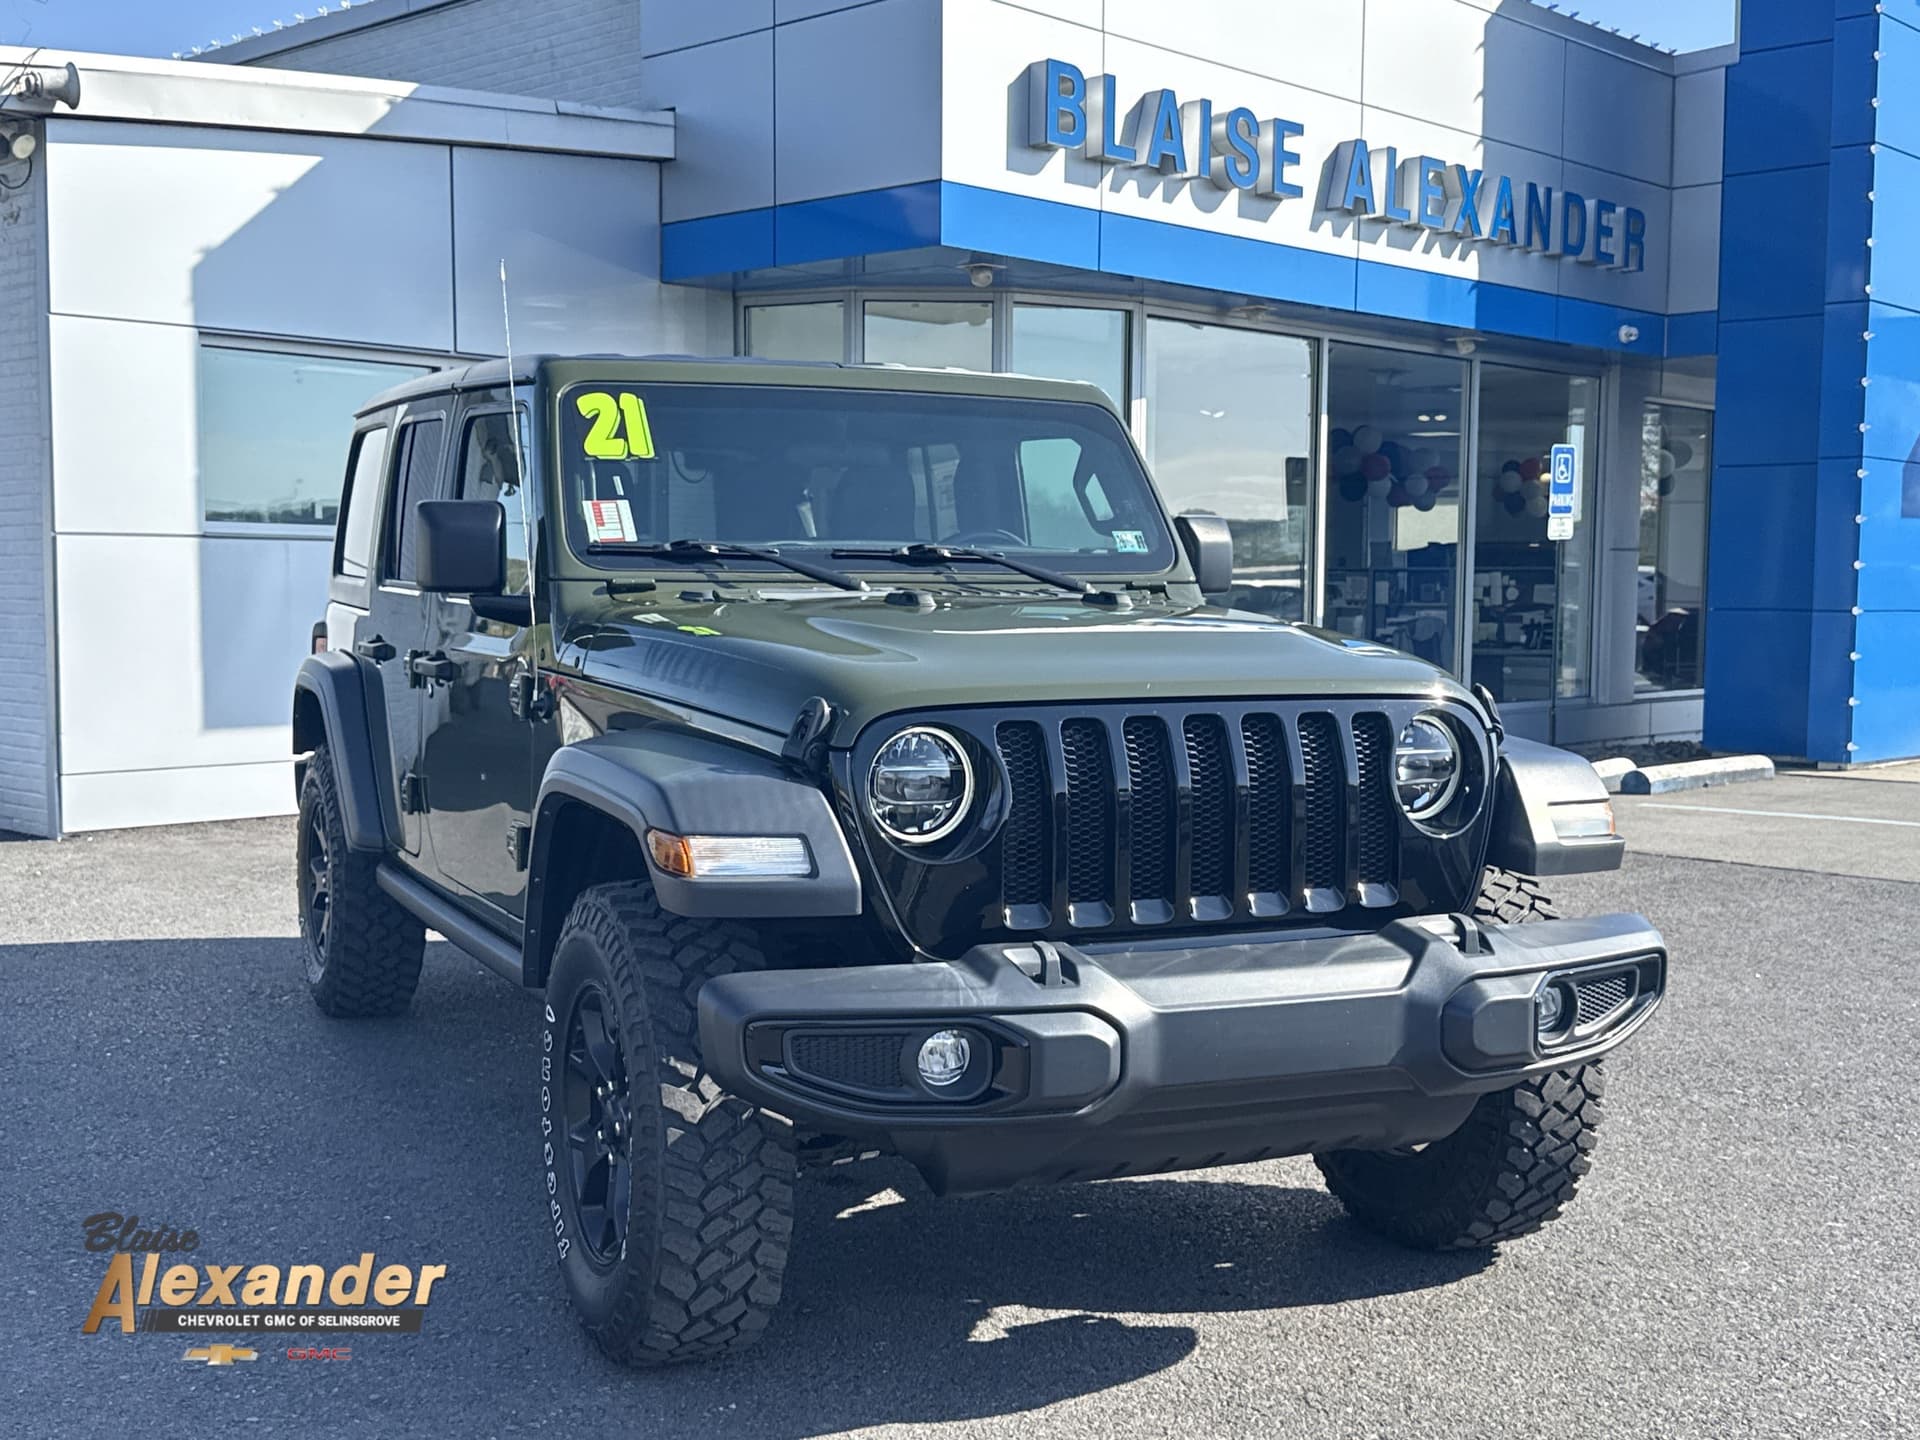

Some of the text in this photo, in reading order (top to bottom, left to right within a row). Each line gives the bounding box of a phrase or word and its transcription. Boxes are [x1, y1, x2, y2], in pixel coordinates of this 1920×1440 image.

[1044, 57, 1647, 272] BLAISE ALEXANDER
[576, 392, 656, 460] 21
